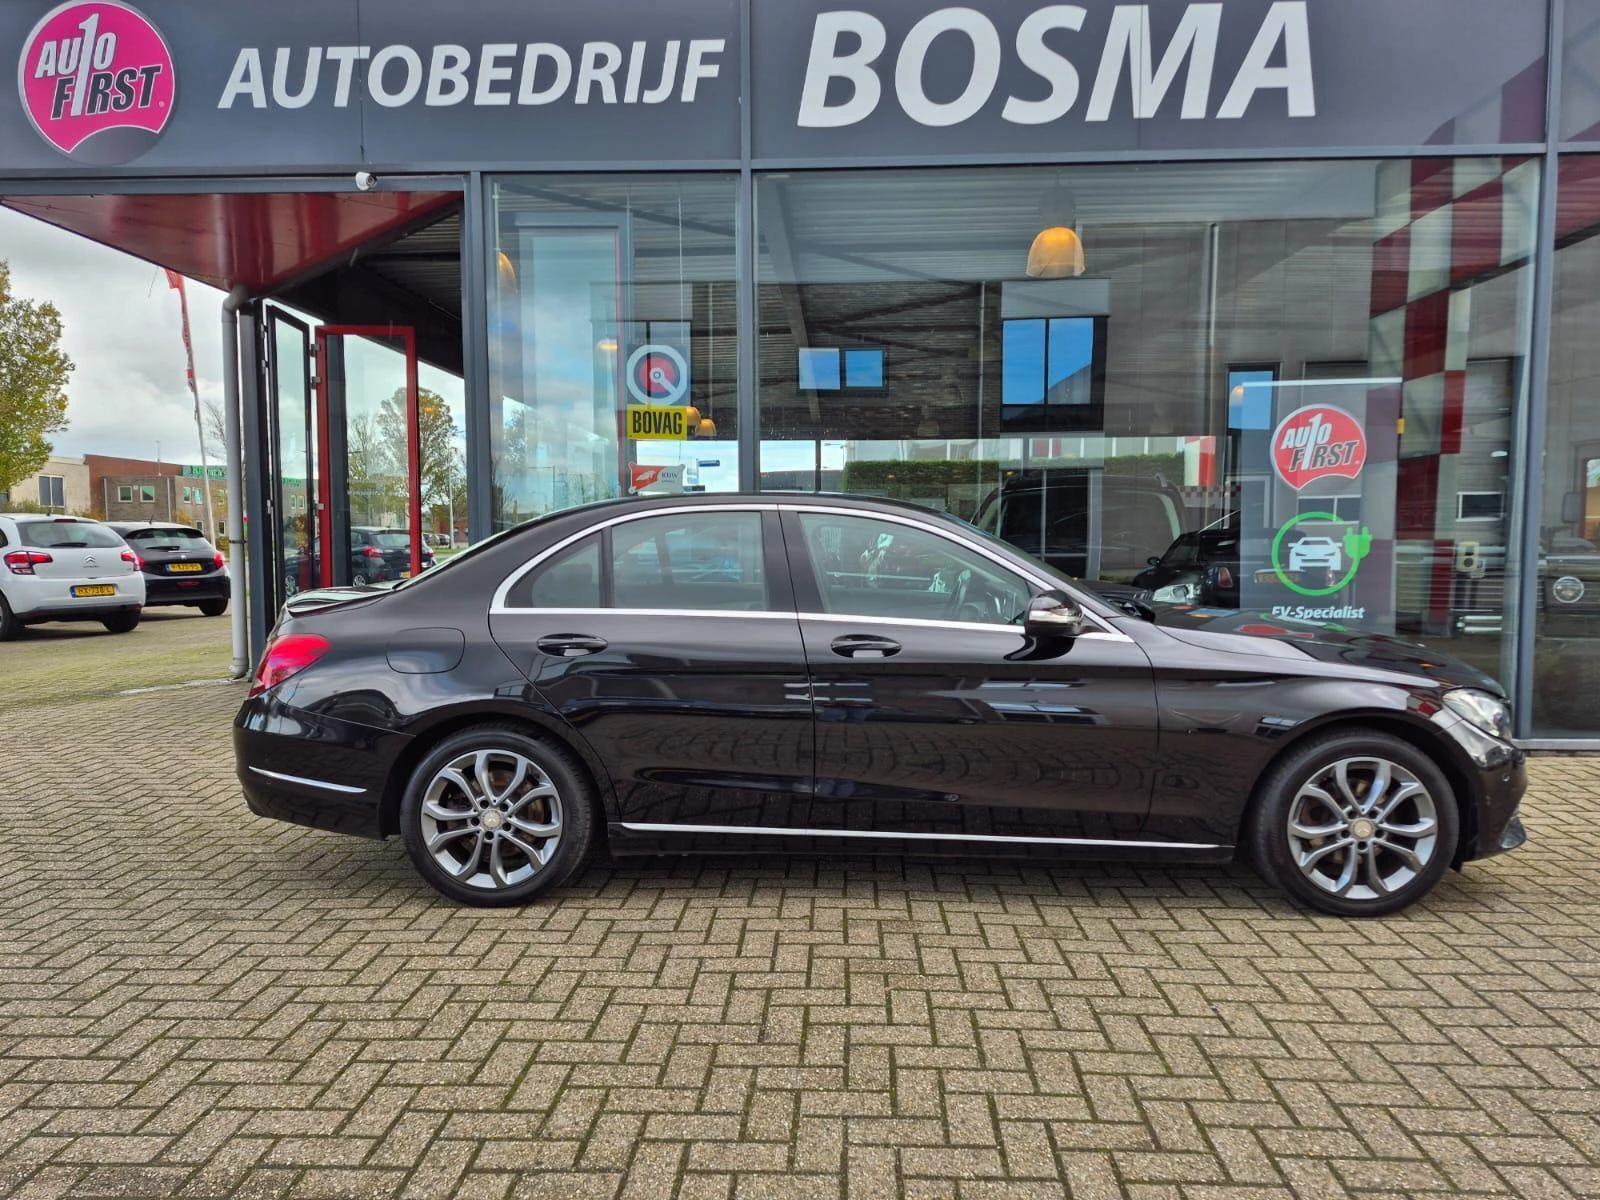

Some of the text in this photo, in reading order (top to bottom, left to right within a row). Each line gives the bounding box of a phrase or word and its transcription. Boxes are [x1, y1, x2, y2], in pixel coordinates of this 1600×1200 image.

[217, 1, 1316, 127] AUTOBEDRIJF BOSMA
[50, 63, 163, 121] FIRST
[632, 410, 682, 435] BOVAG
[1288, 439, 1360, 472] FIRST
